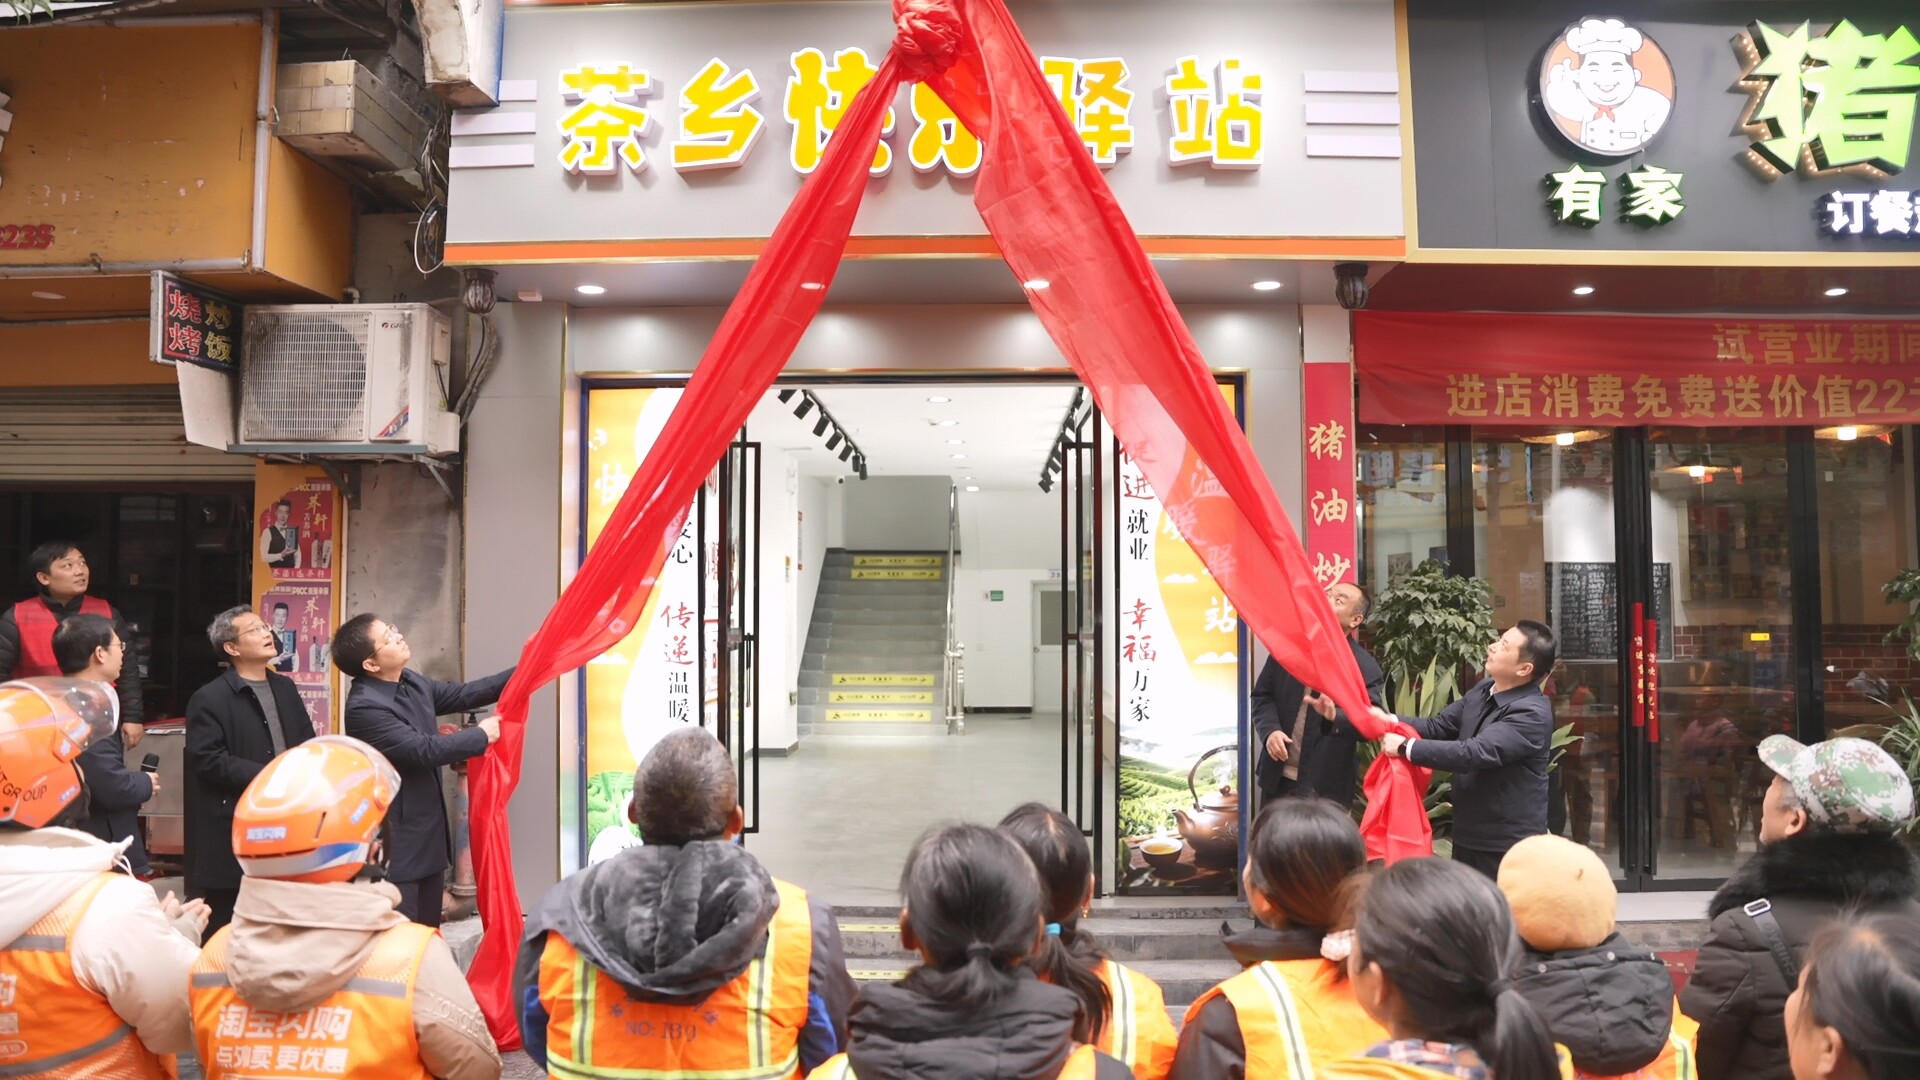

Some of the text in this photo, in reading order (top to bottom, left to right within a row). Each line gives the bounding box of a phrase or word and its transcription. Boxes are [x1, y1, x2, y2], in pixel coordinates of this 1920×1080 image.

[1551, 163, 1687, 223] 有家
[1827, 190, 1920, 235] 订餐
[0, 224, 55, 249] 235
[168, 289, 202, 357] 烧烤
[204, 300, 233, 363] 炒饭
[1446, 373, 1920, 418] 进店消费免费送价值22
[660, 601, 695, 722] 传递温暖
[1122, 597, 1156, 722] 幸福万家
[2, 783, 48, 802] GROUP
